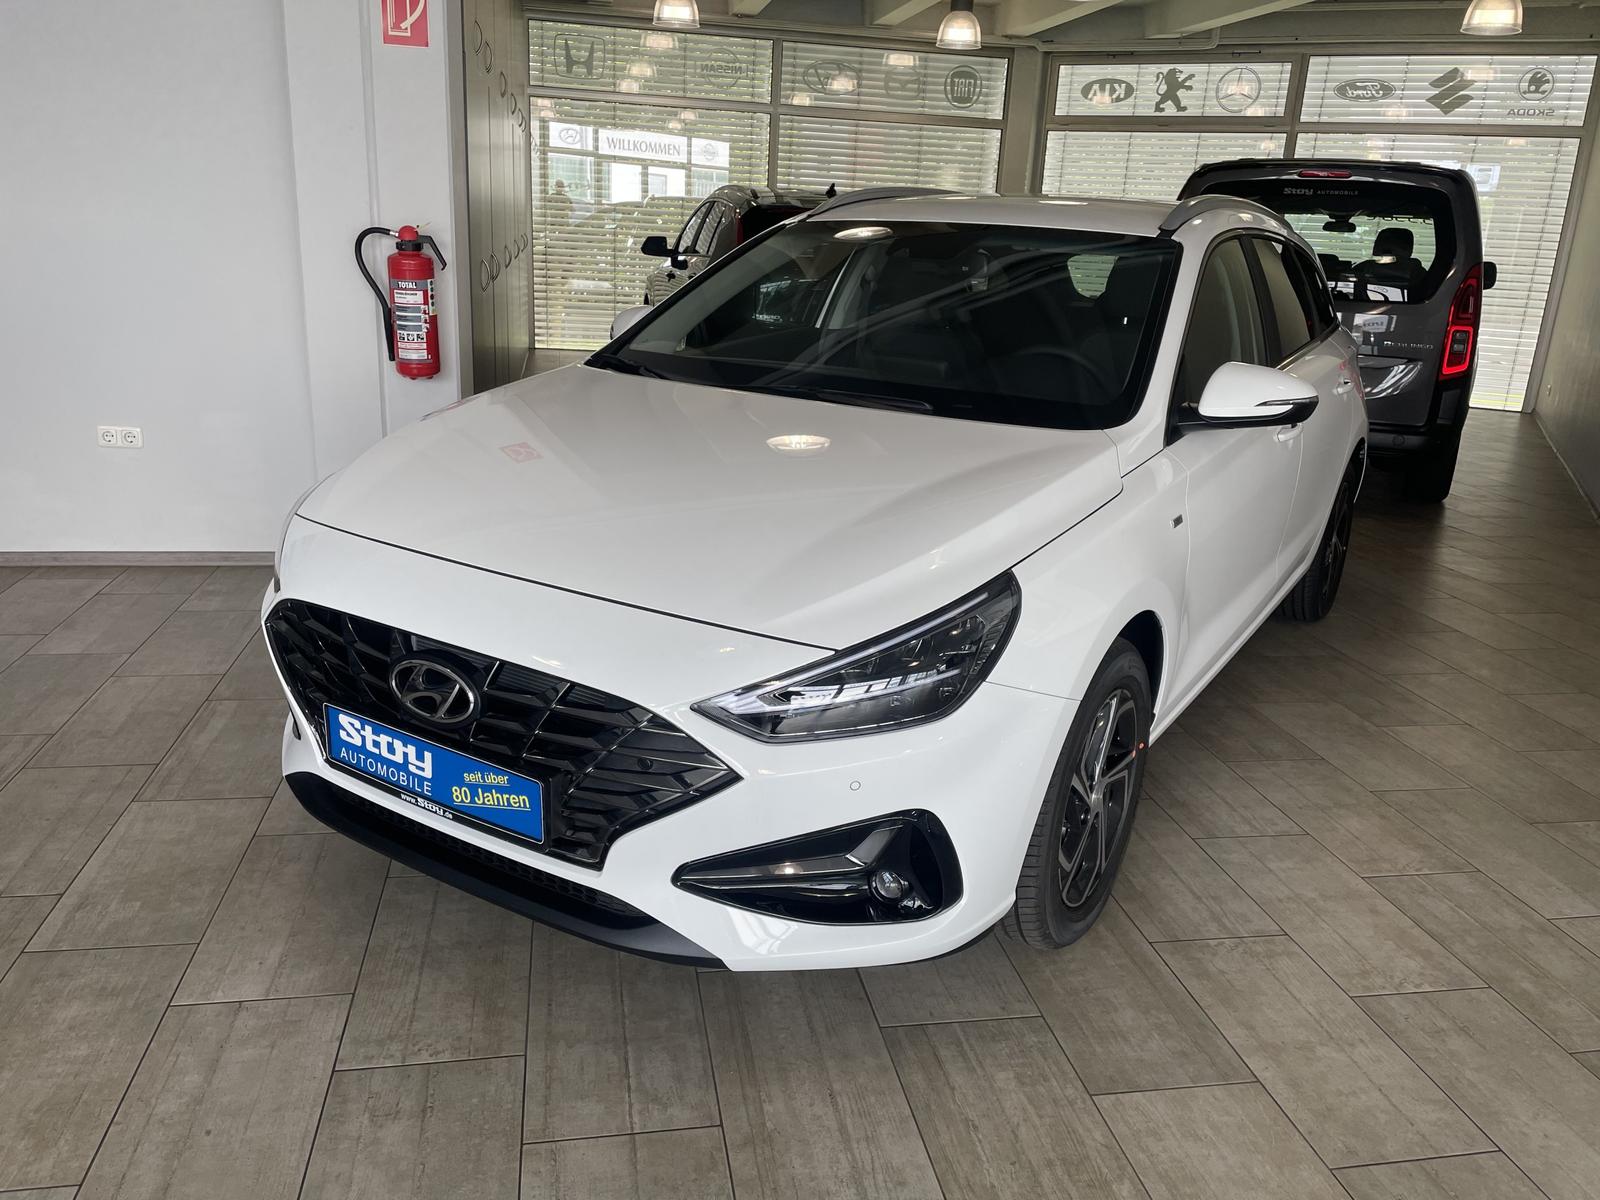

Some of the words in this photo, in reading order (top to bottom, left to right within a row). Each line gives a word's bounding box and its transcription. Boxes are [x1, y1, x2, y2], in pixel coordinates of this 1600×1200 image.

[606, 136, 681, 157] WILLKOMMEN
[1283, 187, 1314, 196] Stoy
[397, 281, 417, 289] TOTAL
[338, 713, 433, 779] Stoy
[340, 747, 432, 796] AUTOMOBILE
[463, 771, 483, 783] seit
[484, 772, 509, 785] über
[451, 786, 471, 804] 80
[474, 787, 530, 809] Jahren
